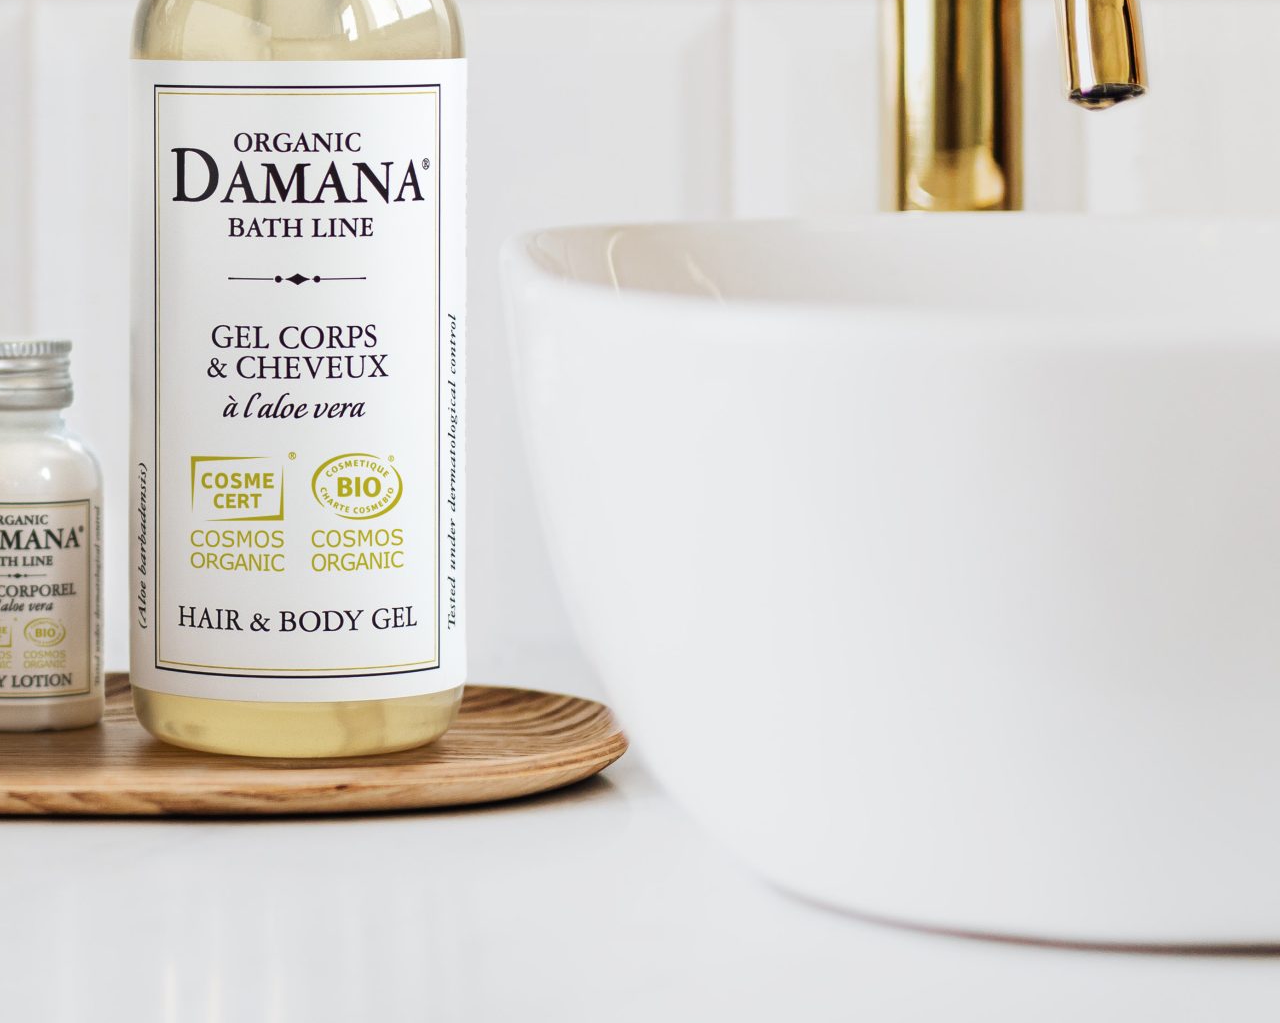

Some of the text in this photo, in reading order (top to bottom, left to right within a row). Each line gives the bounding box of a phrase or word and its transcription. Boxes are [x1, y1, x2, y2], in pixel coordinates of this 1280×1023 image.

[233, 132, 362, 153] ORGANIC
[228, 217, 374, 238] BATH LINE
[211, 324, 378, 350] GEL CORPS
[207, 354, 389, 380] & CHEVEUX
[222, 395, 239, 418] à
[313, 401, 366, 419] vera
[326, 459, 389, 478] COSMETIQUE
[447, 313, 458, 630] Tested under dermatological control
[201, 472, 275, 490] COSME
[337, 476, 381, 498] BIO
[213, 493, 262, 509] CERT
[320, 487, 394, 514] CHARTE COSMEBIO
[190, 530, 284, 548] COSMOS
[311, 529, 403, 548] COSMOS
[22, 556, 53, 566] LINE
[190, 552, 285, 572] ORGANIC
[311, 551, 404, 572] ORGANIC
[28, 603, 53, 611] vera
[178, 605, 417, 633] HAIR & BODY GEL
[35, 628, 55, 637] BIO
[11, 673, 72, 687] LOTION
